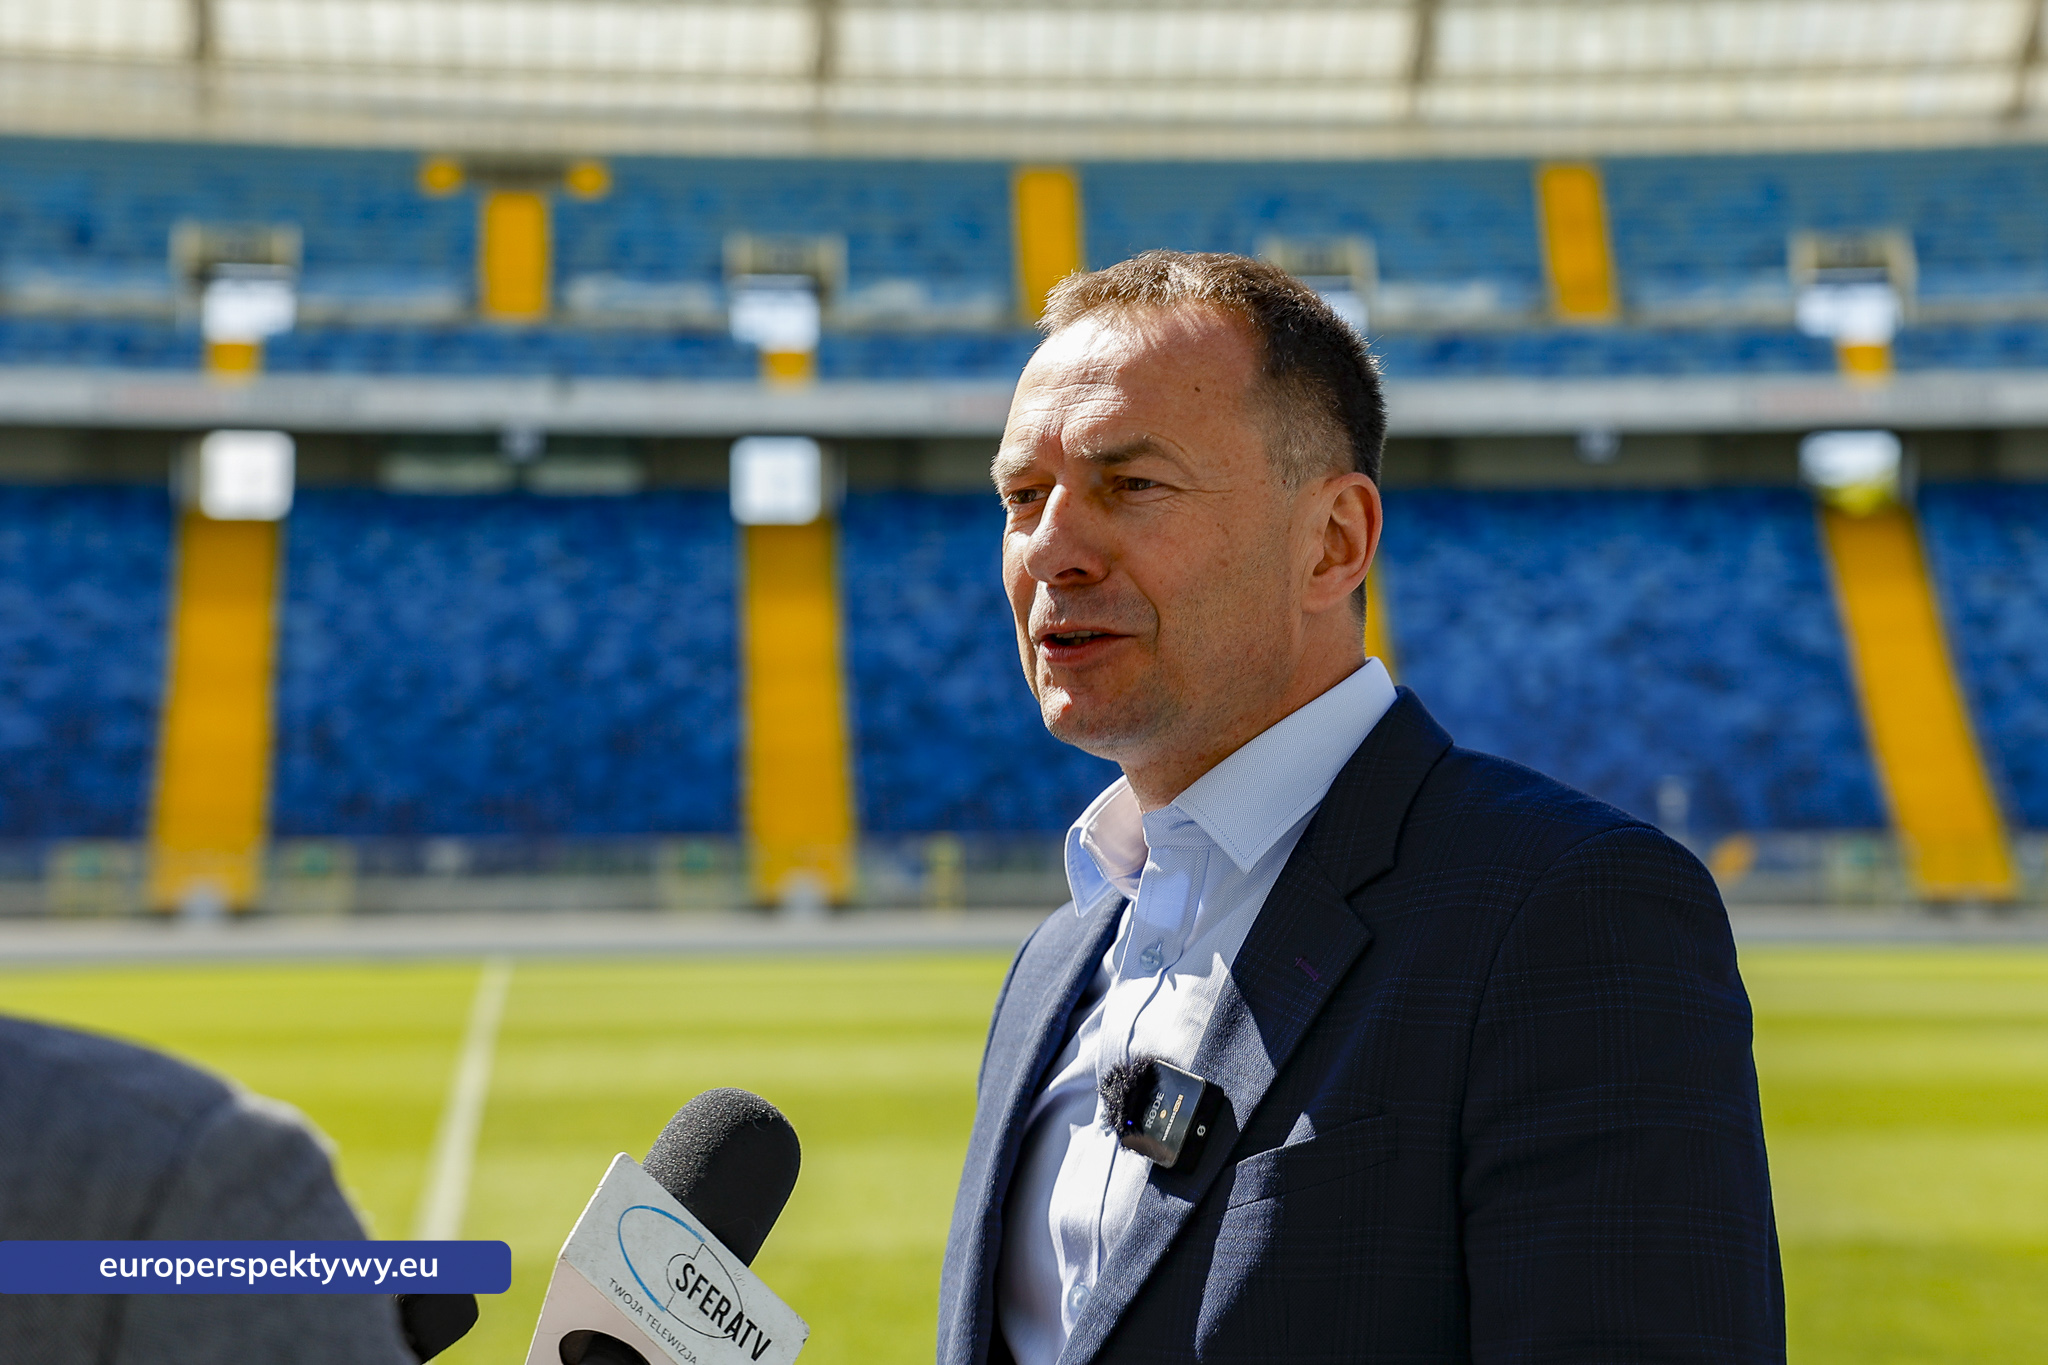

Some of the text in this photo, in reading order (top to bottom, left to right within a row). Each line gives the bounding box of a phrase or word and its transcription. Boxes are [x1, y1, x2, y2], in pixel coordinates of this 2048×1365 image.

[1145, 1092, 1165, 1129] RØDE
[609, 1277, 698, 1365] TWOJA TELEWIZJA
[675, 1263, 772, 1362] SFERATV
